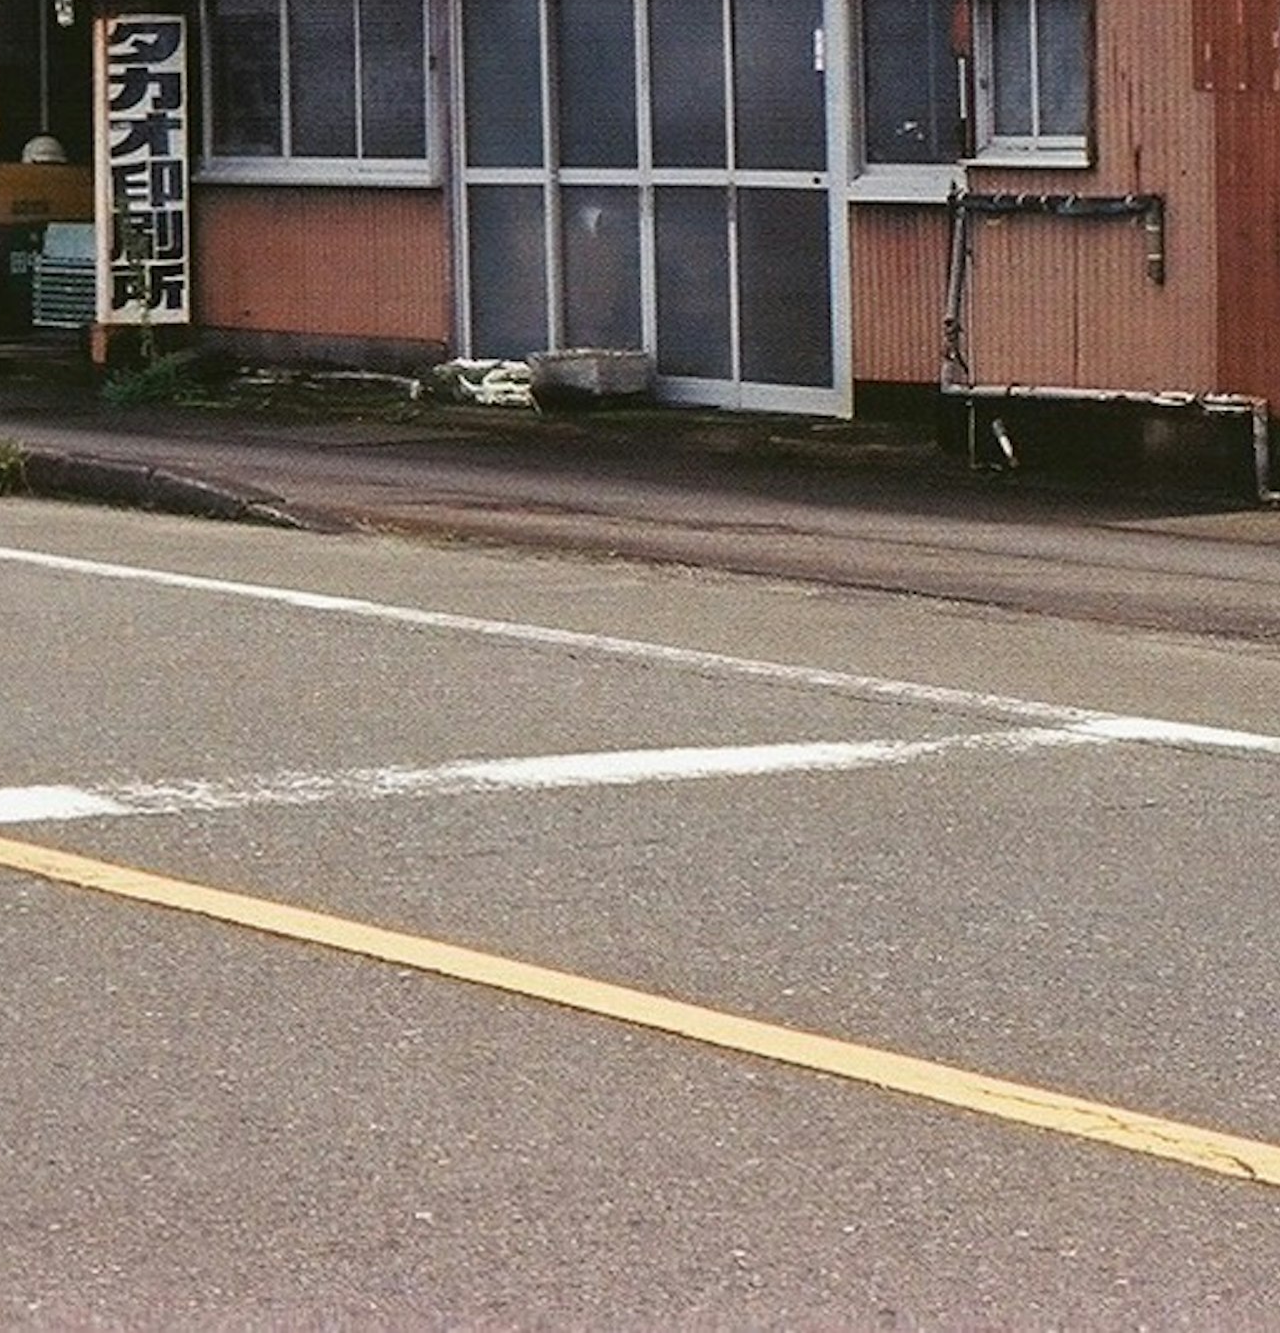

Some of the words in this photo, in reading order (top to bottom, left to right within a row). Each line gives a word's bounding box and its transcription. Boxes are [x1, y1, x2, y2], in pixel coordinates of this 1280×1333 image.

[108, 22, 186, 311] タカオ印刷所
